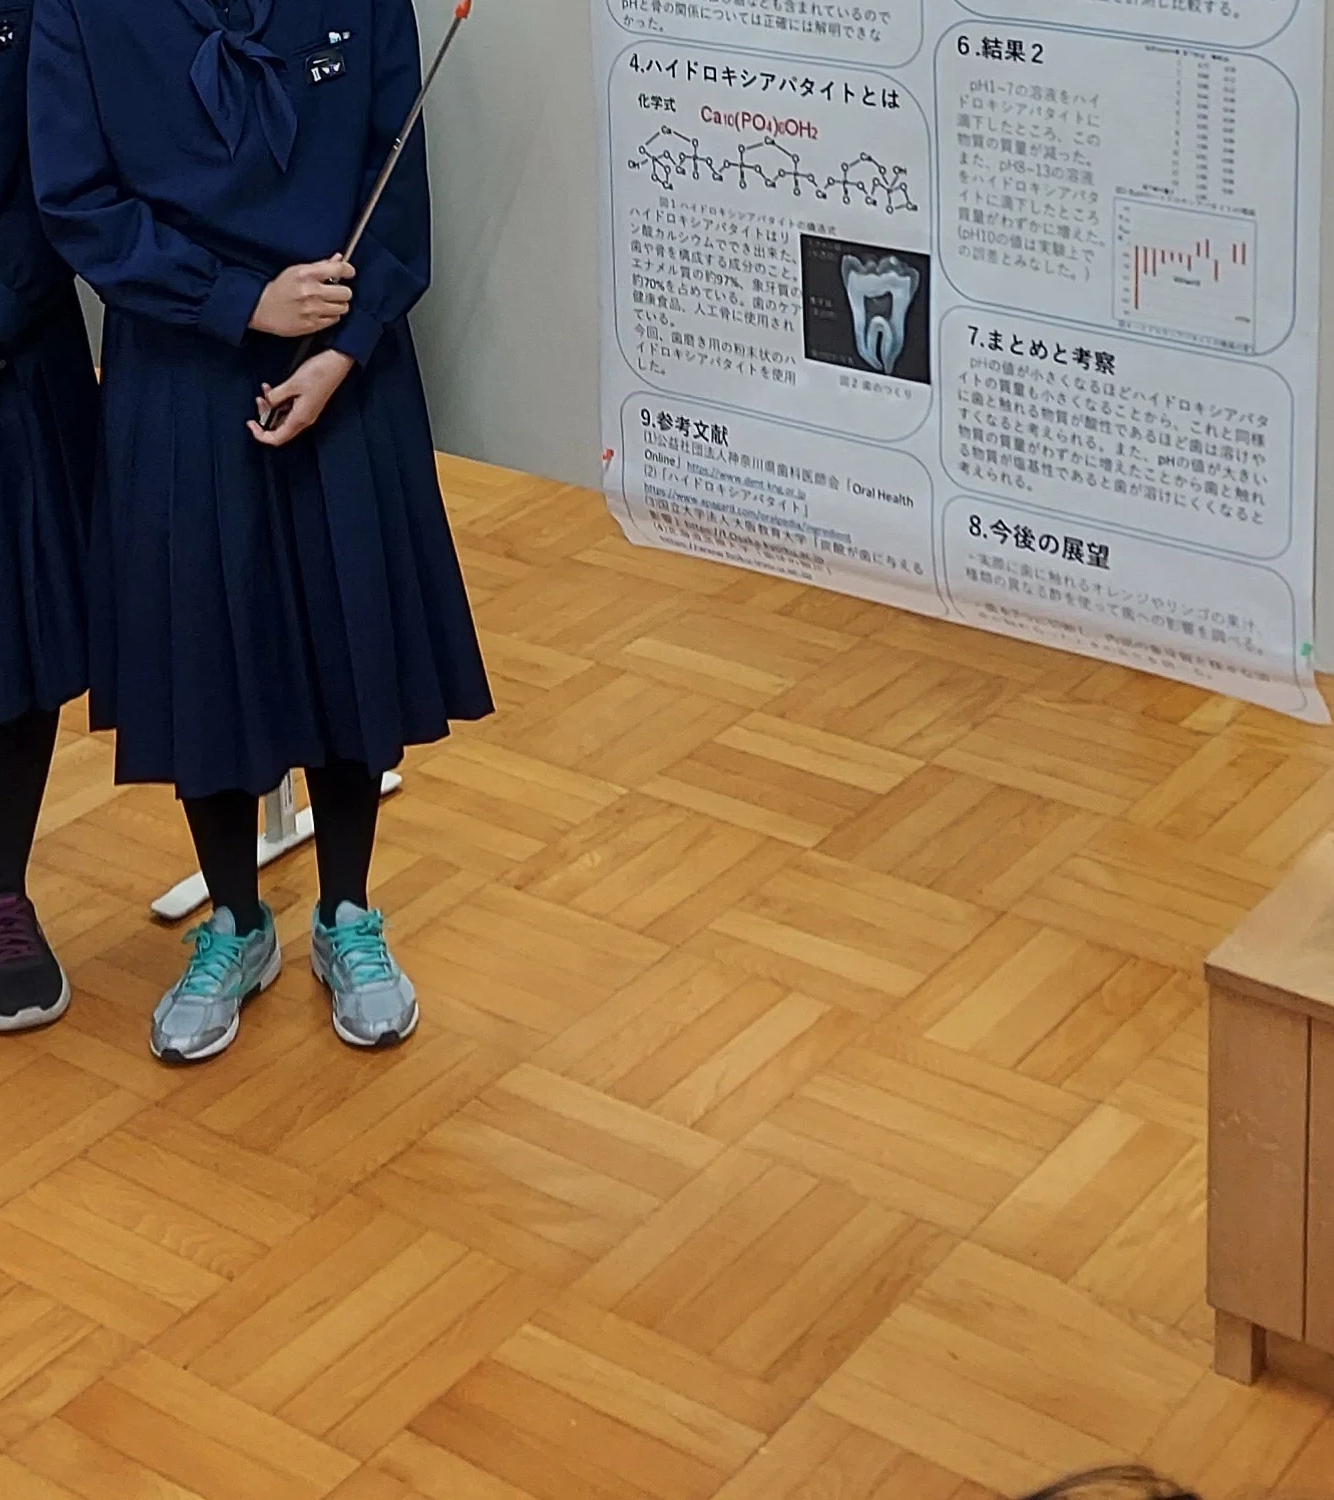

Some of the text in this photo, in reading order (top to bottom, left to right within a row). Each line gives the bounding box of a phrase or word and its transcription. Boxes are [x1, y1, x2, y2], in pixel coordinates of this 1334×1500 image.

[629, 53, 900, 109] 4.ハイドロキシアパタイトとは
[638, 94, 676, 112] 化学式
[968, 326, 1116, 376] 7.まとめと考察
[640, 408, 728, 447] 9.参考文献
[969, 515, 1110, 570] 8.今後の展望
